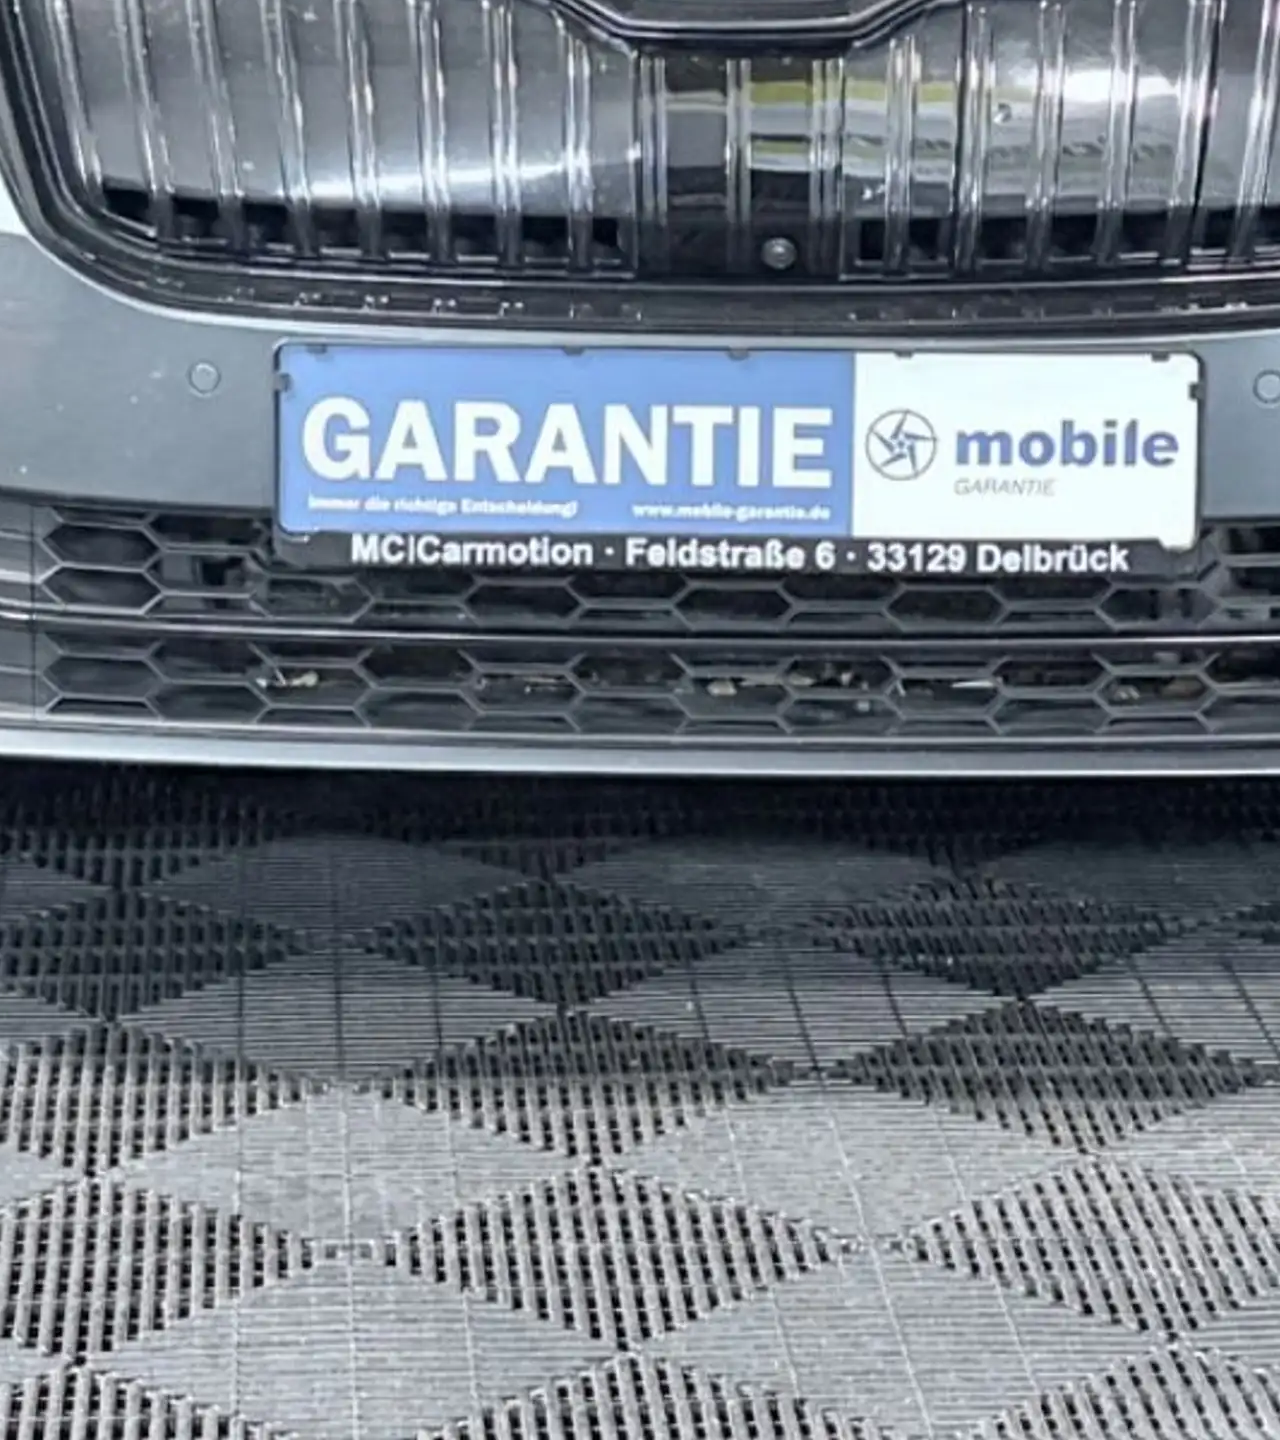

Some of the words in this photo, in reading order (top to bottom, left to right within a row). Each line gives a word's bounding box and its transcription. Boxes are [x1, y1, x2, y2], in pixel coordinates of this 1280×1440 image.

[303, 396, 833, 488] GARANTIE
[955, 418, 1179, 468] mobile
[954, 477, 1057, 497] GARANTIE
[365, 496, 390, 511] die
[394, 497, 457, 515] richtige
[632, 503, 831, 522] www.mobile-garantie.de
[625, 537, 806, 570] Feldstraße
[815, 541, 836, 570] 6
[868, 543, 967, 572] 33129
[976, 544, 1130, 573] Delbrück
